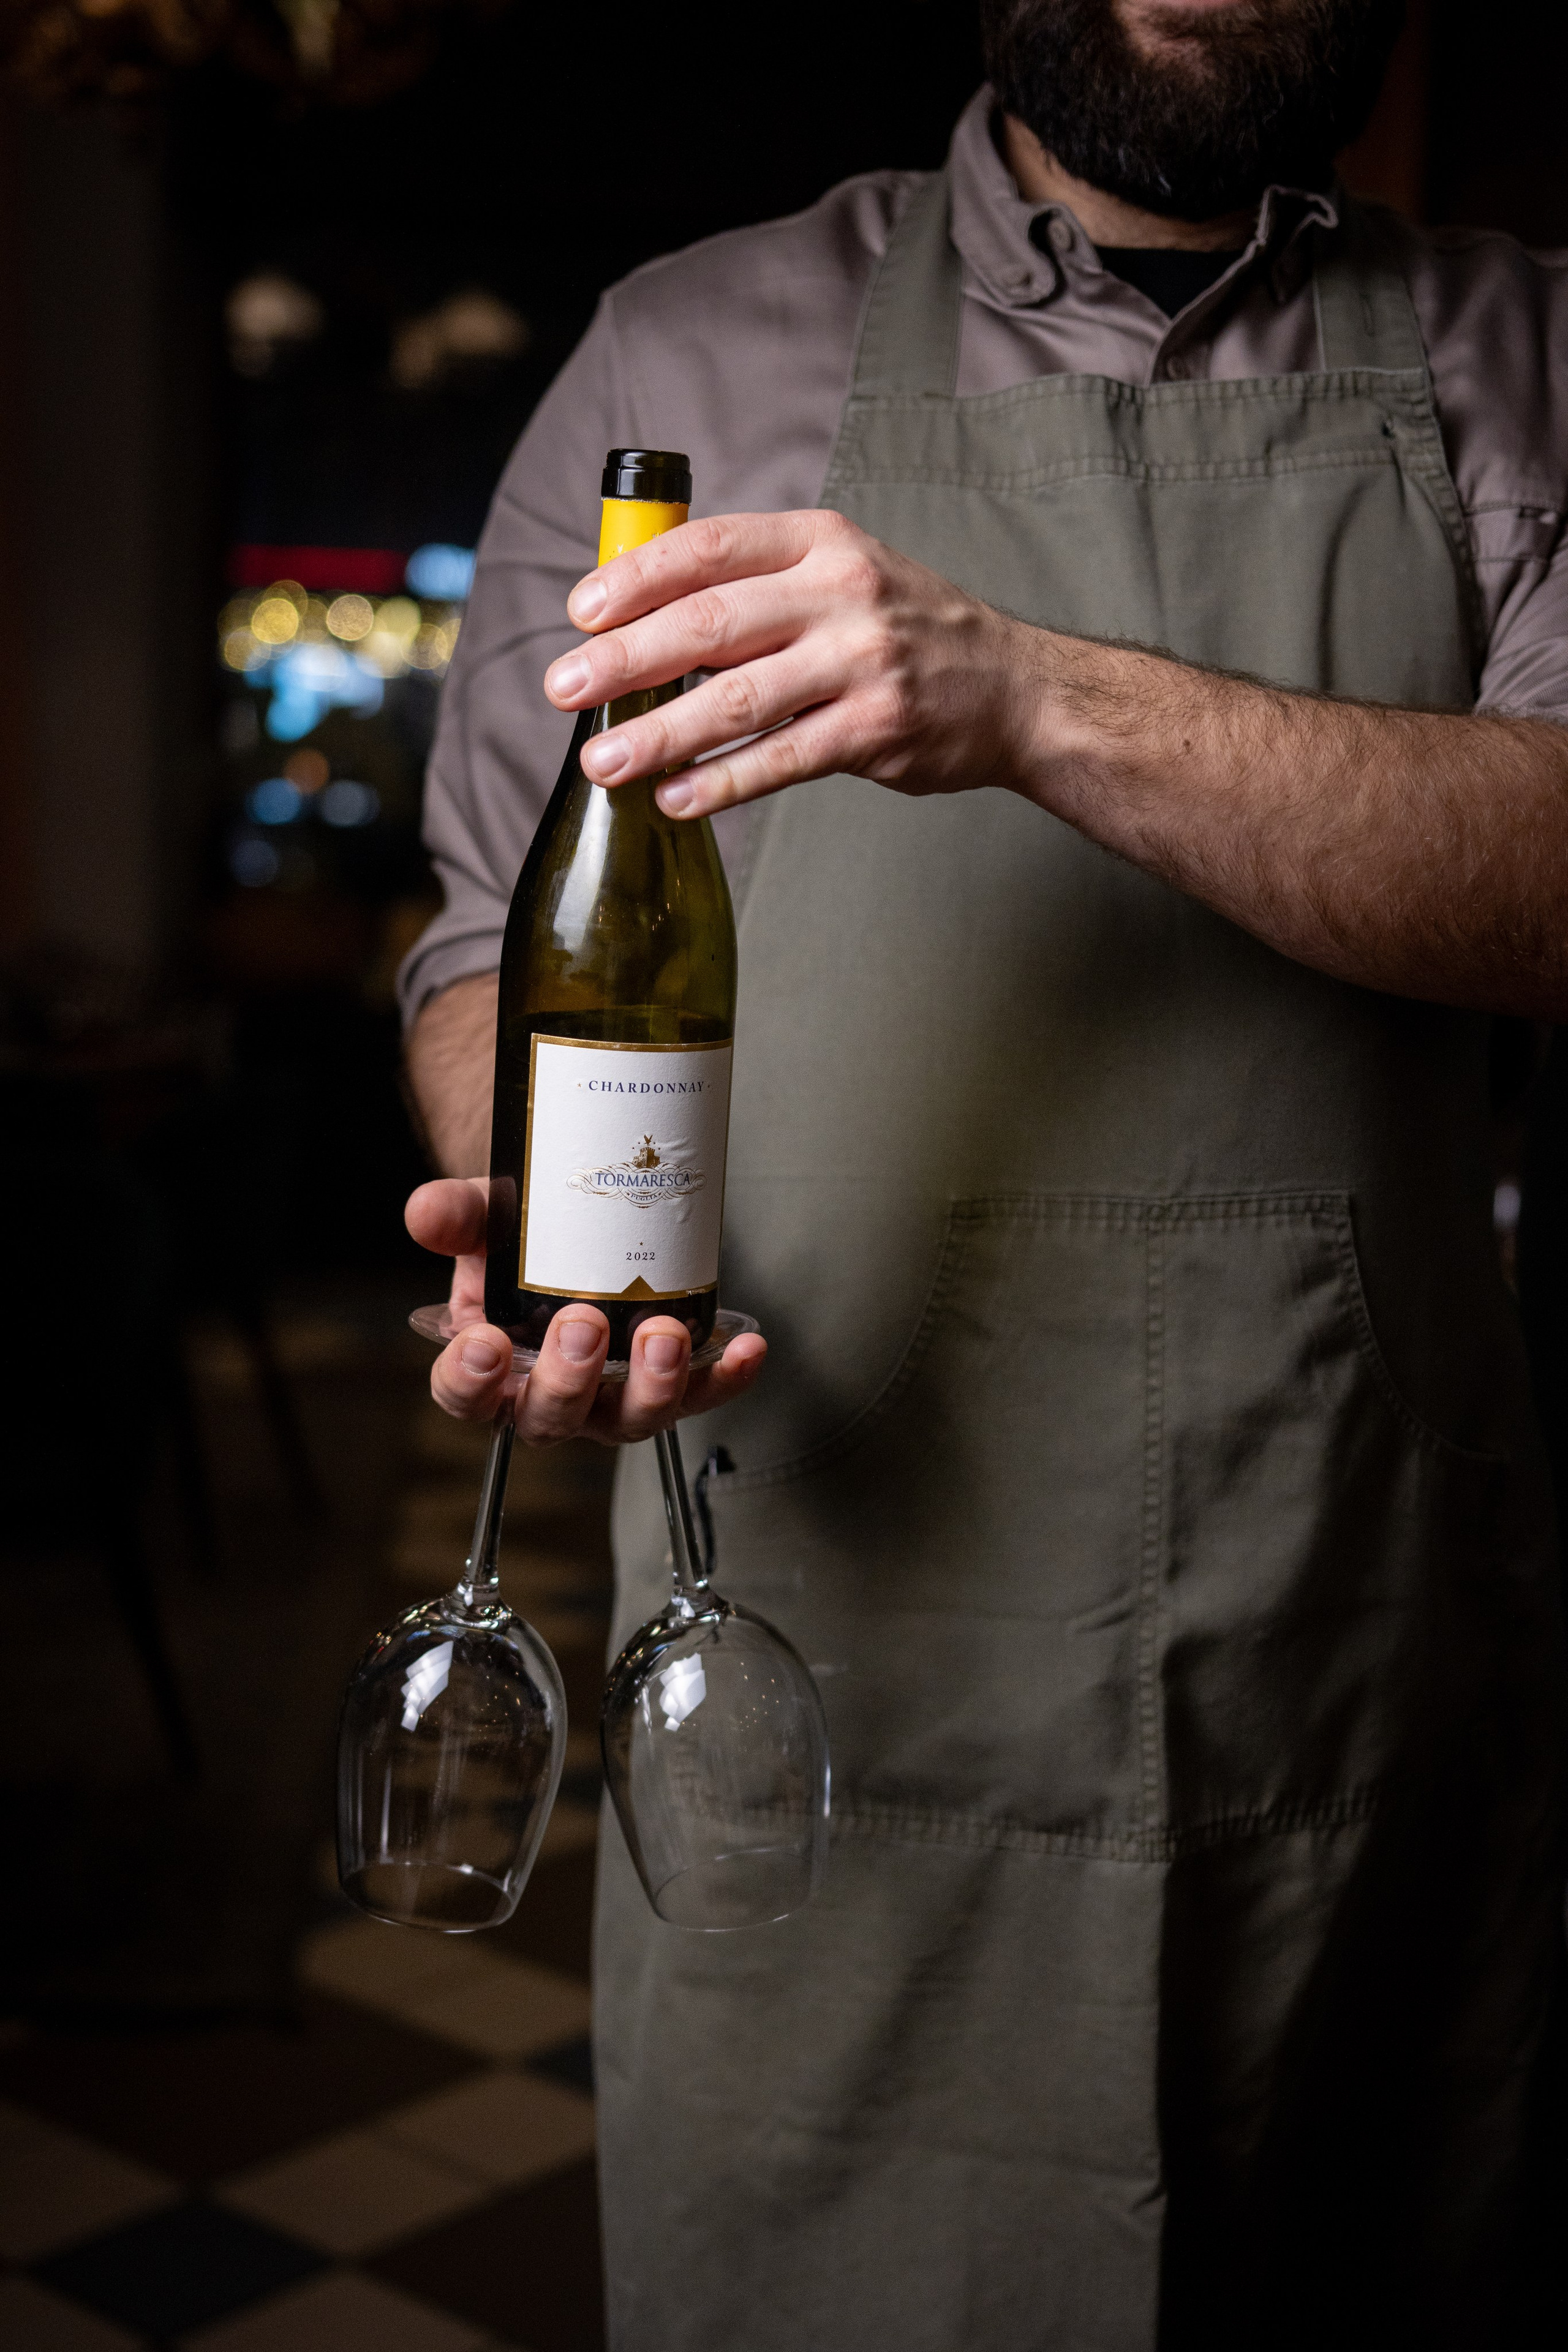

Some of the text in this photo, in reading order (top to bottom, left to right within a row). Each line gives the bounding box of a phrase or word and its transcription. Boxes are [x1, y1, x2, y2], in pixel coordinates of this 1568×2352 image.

[589, 1080, 704, 1093] CHARDONNAY
[595, 1172, 690, 1187] TORMARESCA
[626, 1251, 655, 1261] 2022
